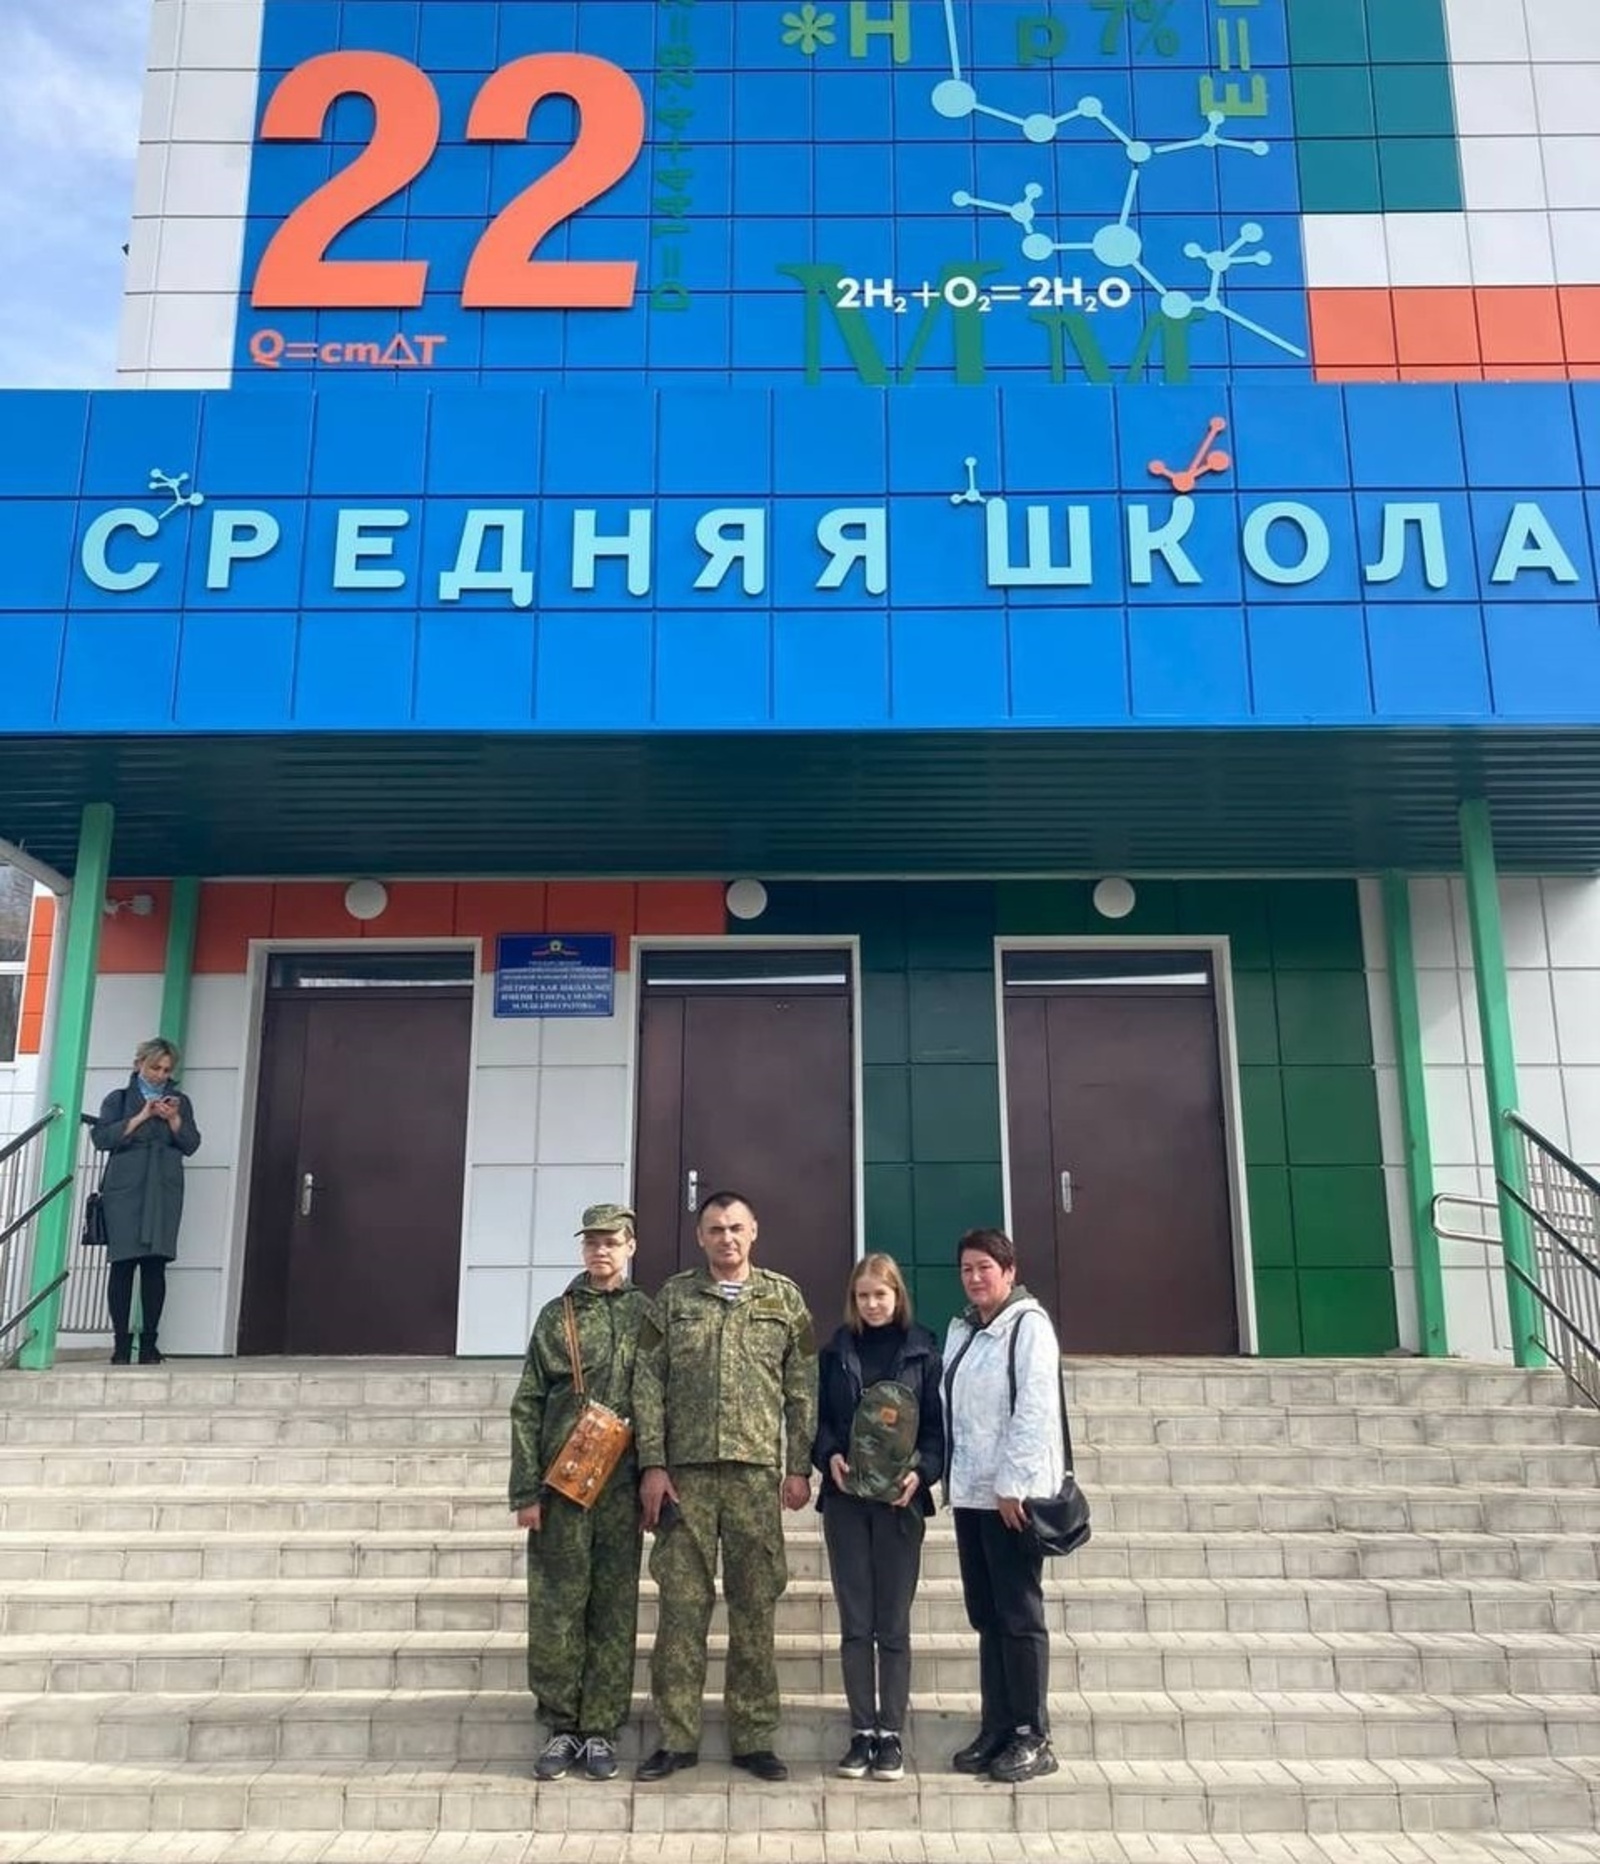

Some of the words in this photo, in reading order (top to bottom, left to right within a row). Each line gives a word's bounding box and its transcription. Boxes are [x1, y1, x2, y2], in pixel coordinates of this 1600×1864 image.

[1200, 0, 1268, 116] E=
[251, 50, 645, 308] 22
[81, 507, 887, 608] СРЕДНЯЯ
[986, 496, 1580, 589] ШКОЛА
